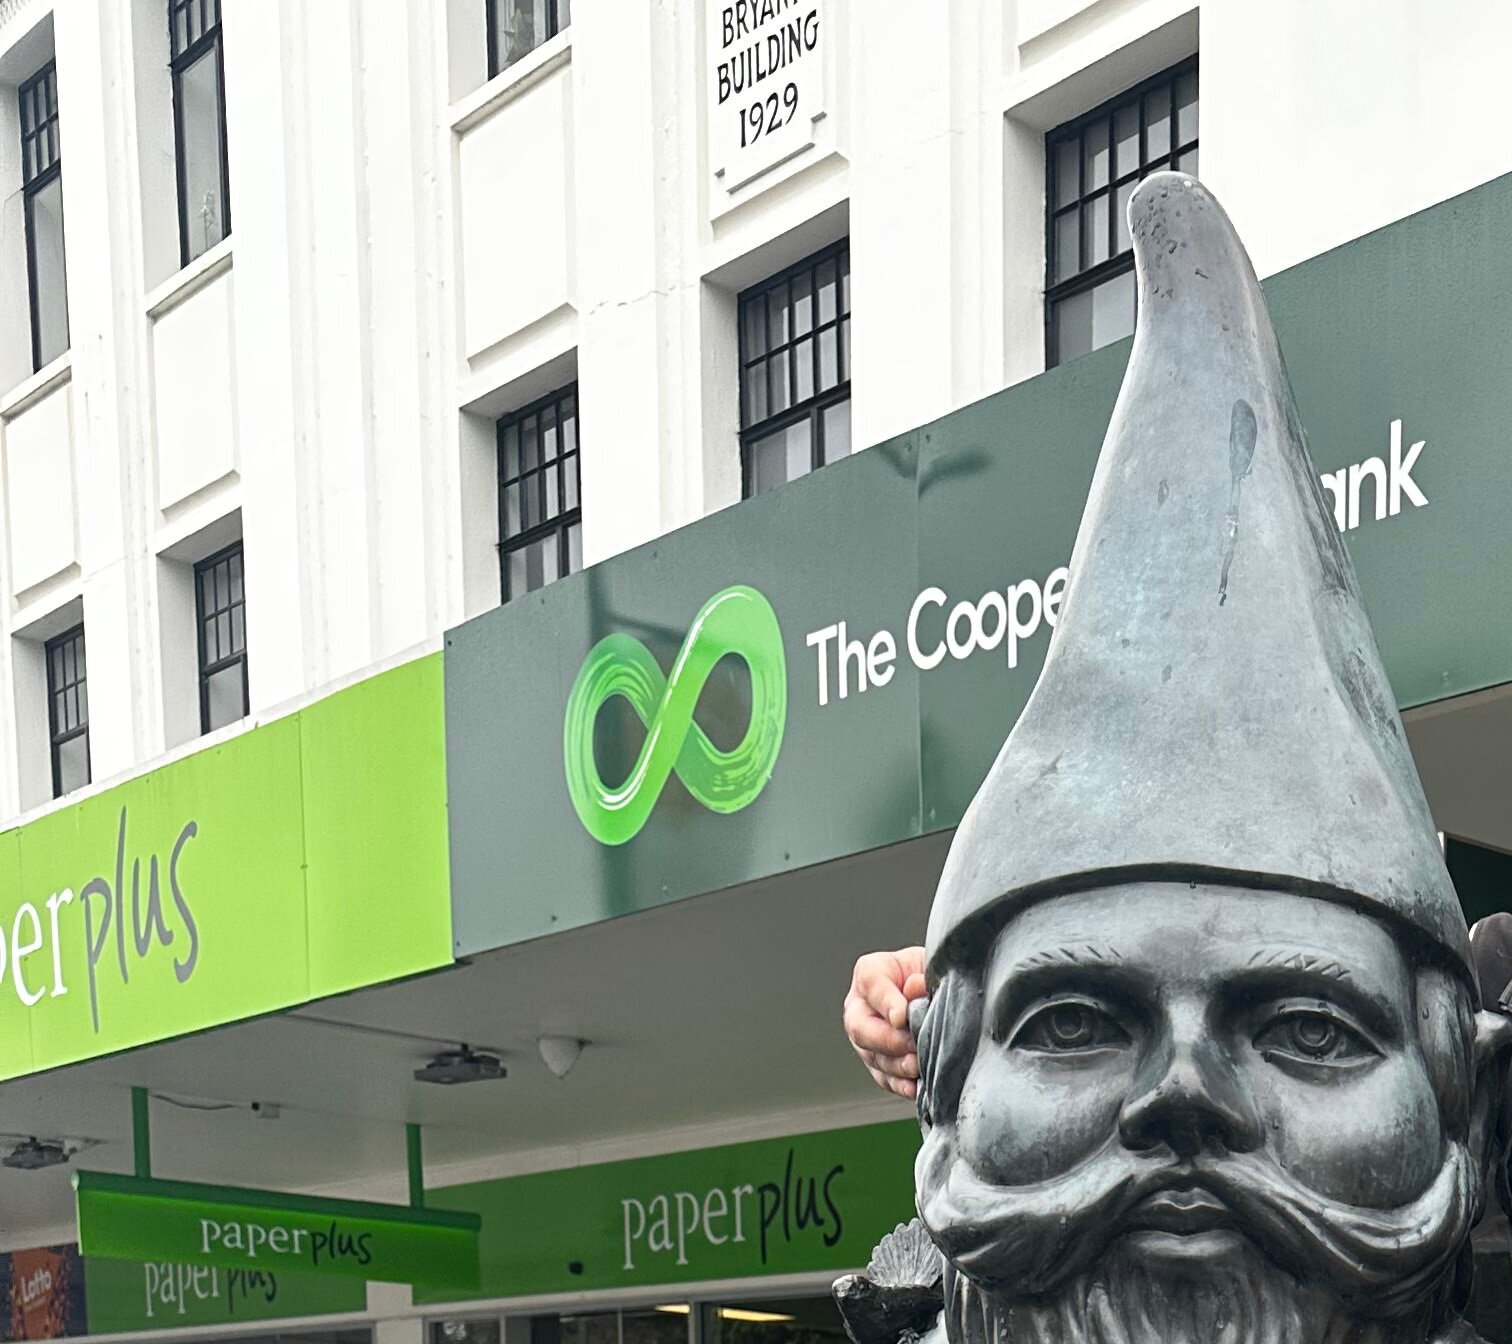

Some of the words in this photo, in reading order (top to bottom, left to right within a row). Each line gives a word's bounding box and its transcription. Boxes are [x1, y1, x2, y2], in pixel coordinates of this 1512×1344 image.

[717, 9, 820, 105] BUILDING
[722, 0, 798, 49] BRYA
[739, 82, 798, 148] 1929
[806, 620, 897, 706] The
[906, 567, 1069, 670] Coope
[1320, 418, 1430, 533] ank
